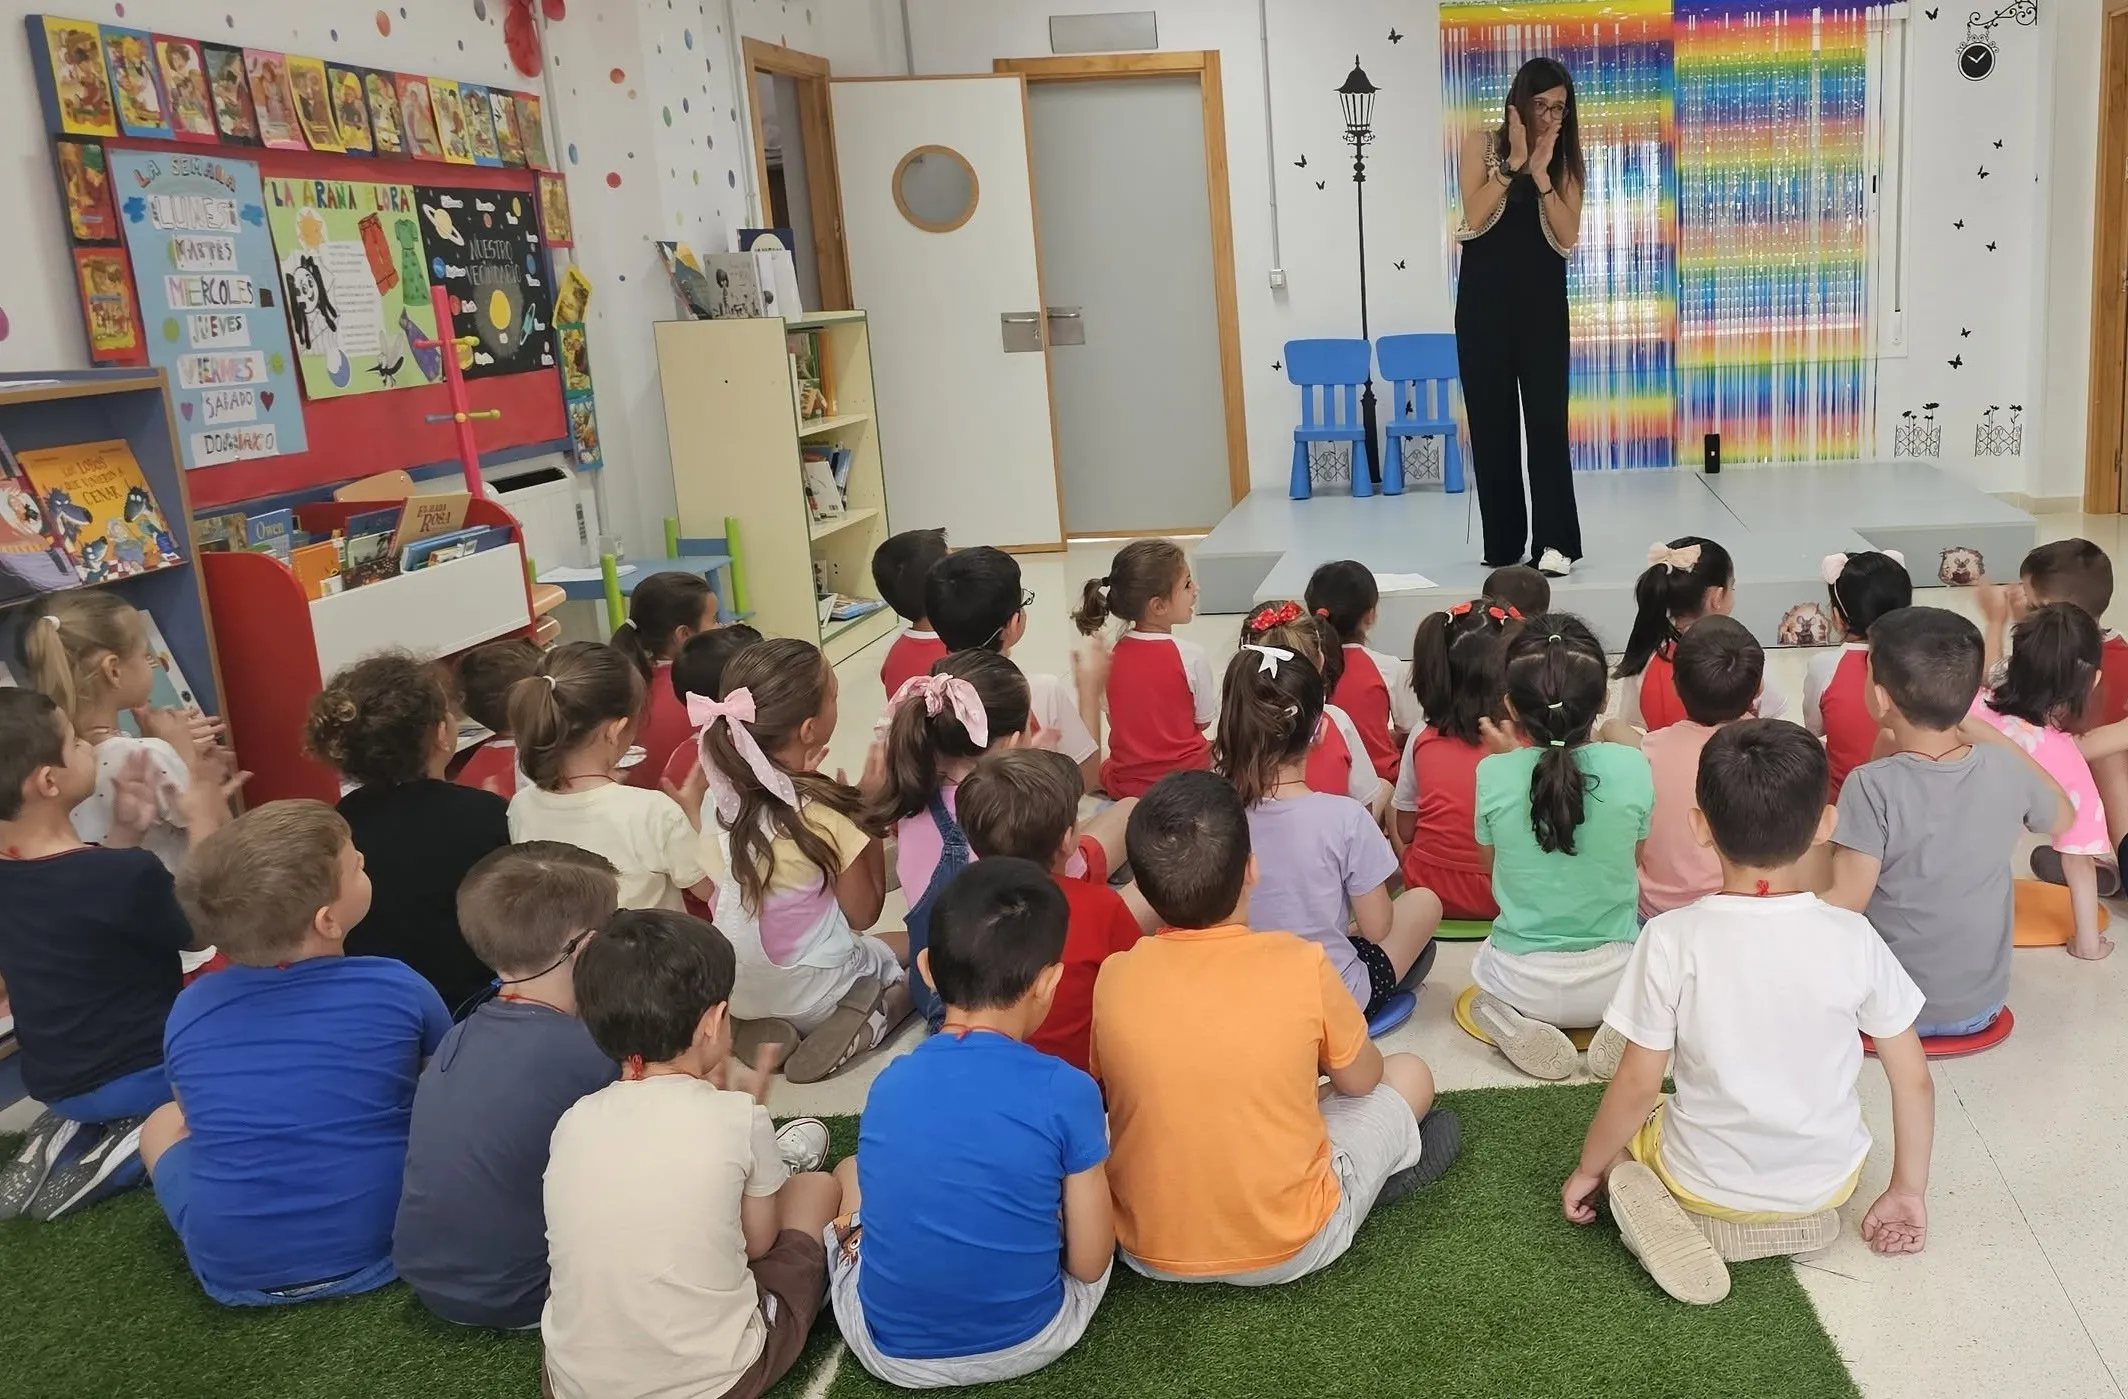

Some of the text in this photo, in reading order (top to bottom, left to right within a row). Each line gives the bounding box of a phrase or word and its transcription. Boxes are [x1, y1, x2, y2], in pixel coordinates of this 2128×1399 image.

[133, 157, 237, 193] LA SEMANA
[271, 181, 295, 208] LA
[469, 235, 514, 264] NUESTRO
[192, 315, 243, 343] JUEVES
[181, 357, 255, 384] VIERNES
[256, 521, 285, 540] Owen
